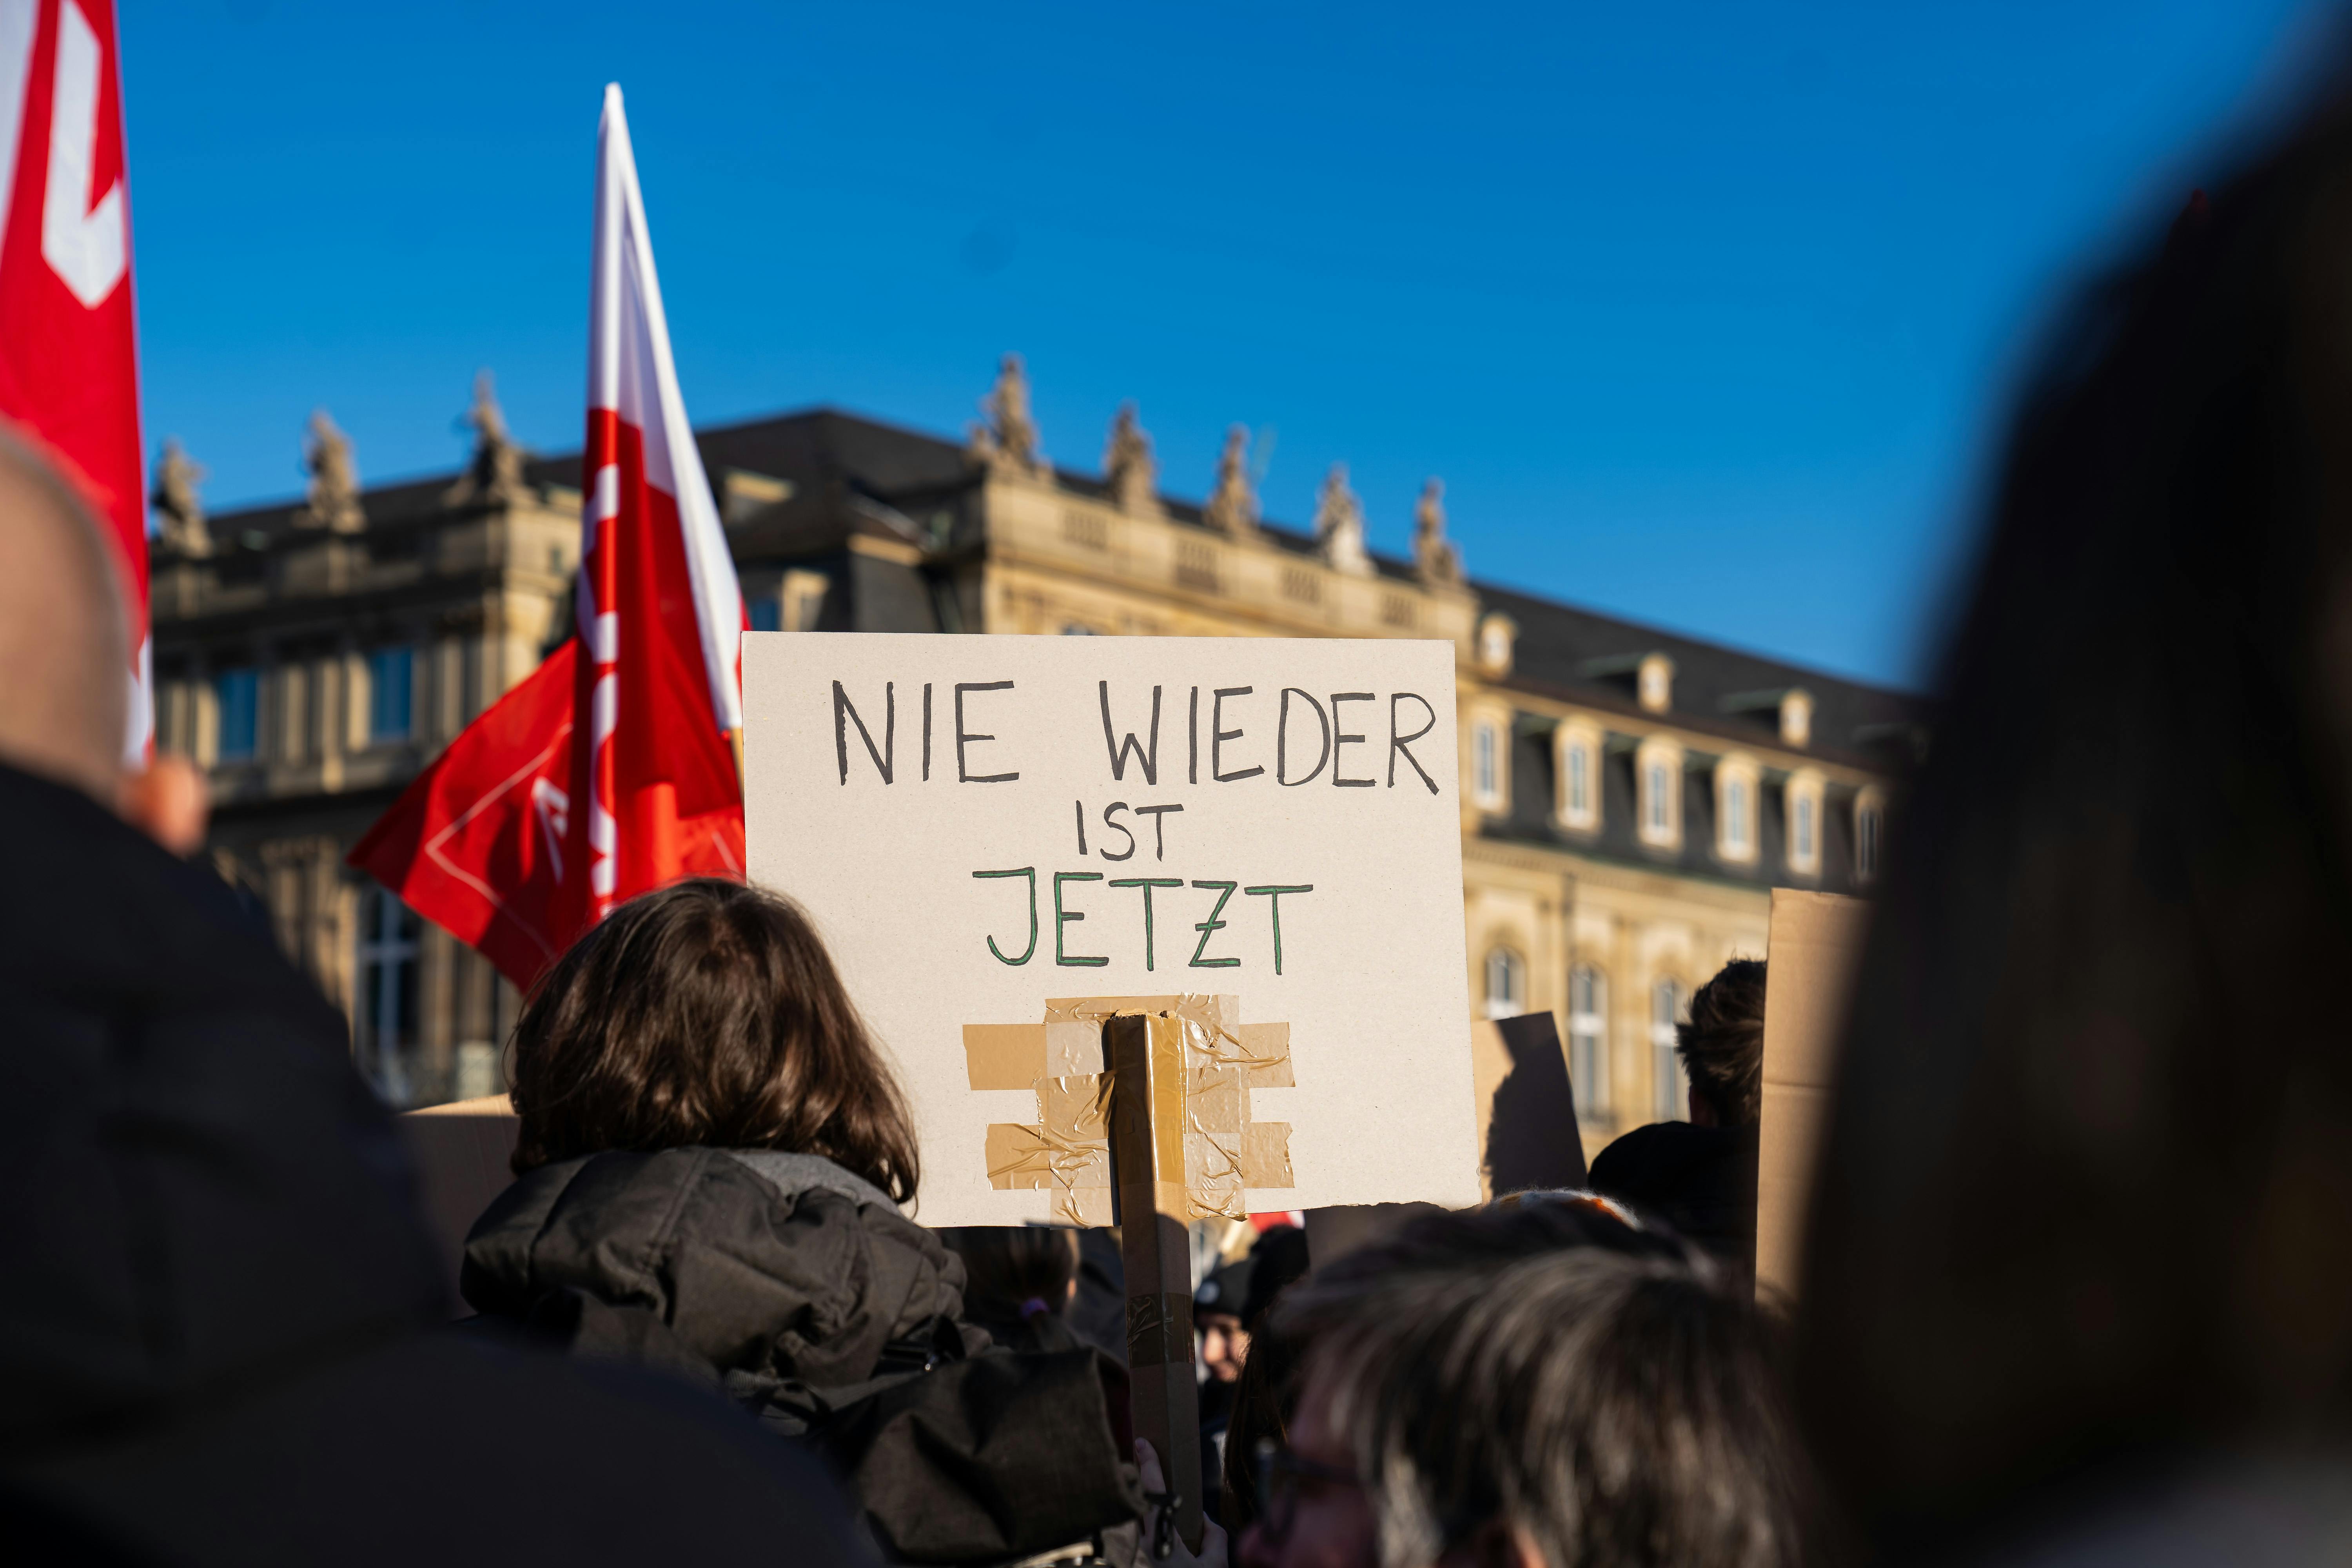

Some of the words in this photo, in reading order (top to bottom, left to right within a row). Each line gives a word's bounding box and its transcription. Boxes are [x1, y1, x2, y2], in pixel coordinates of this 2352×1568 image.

[832, 680, 1020, 786] NIE
[1098, 680, 1440, 796] WIEDER
[1075, 800, 1184, 862] IST
[972, 866, 1314, 976] JETZT
